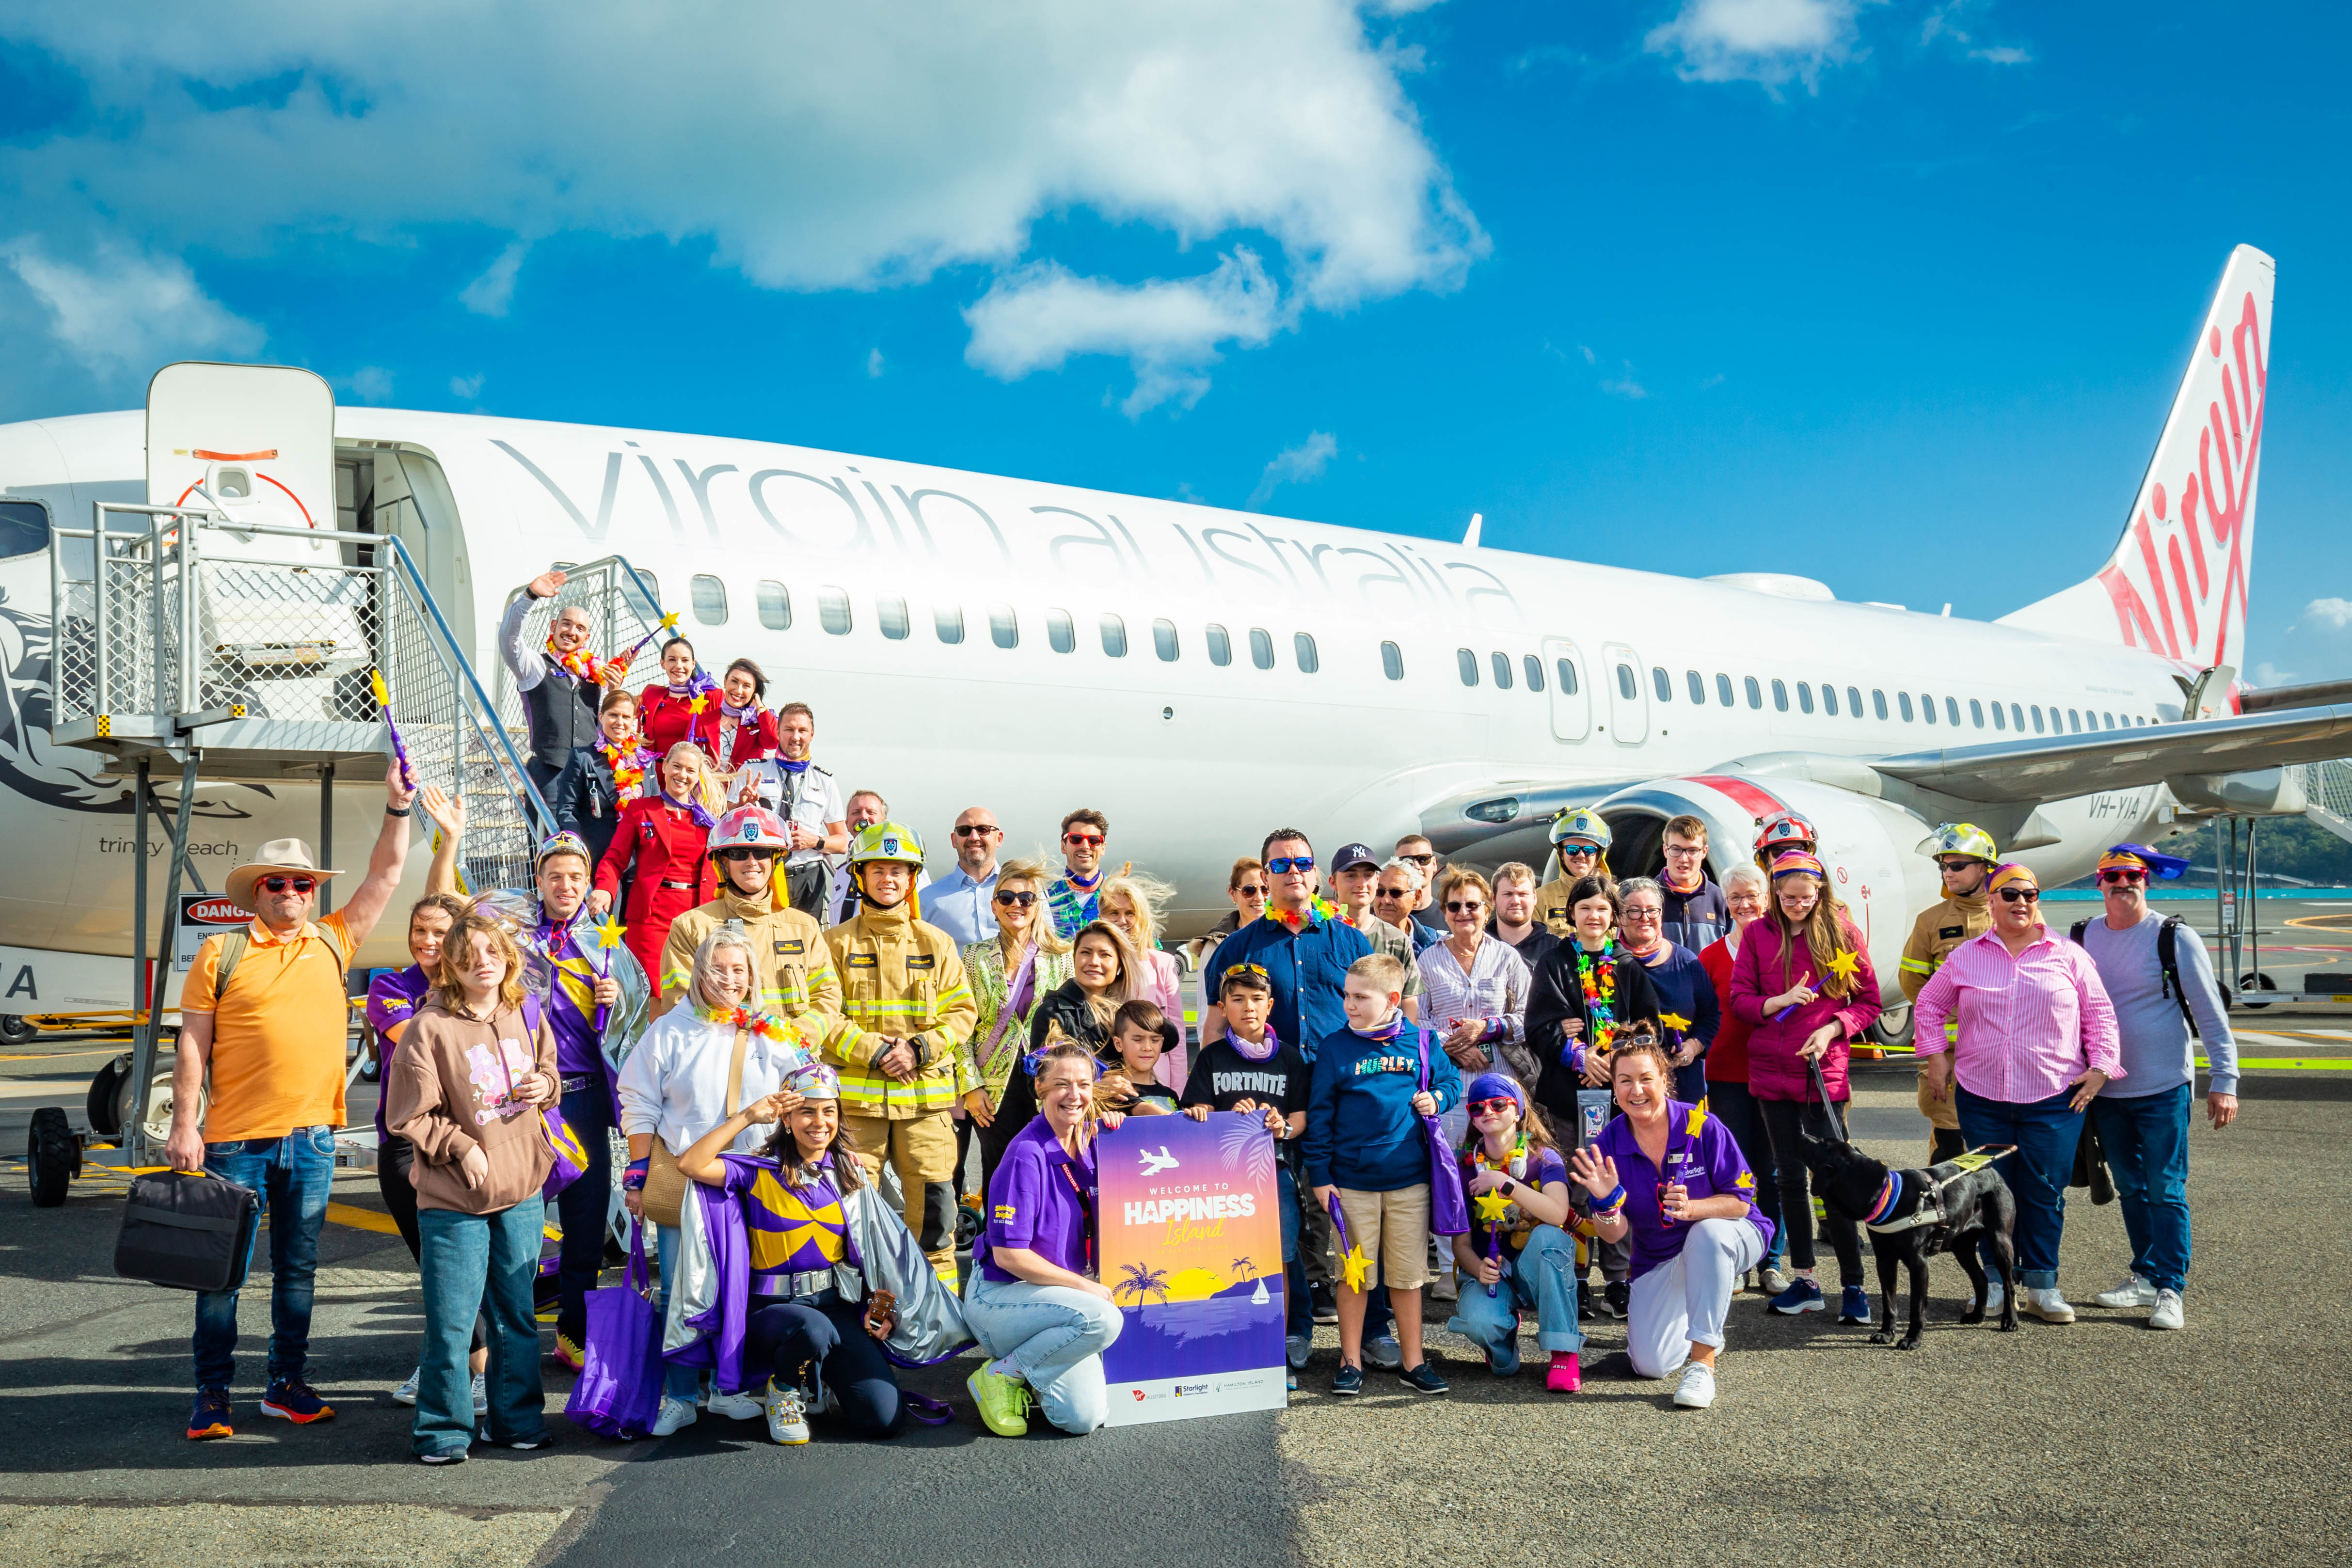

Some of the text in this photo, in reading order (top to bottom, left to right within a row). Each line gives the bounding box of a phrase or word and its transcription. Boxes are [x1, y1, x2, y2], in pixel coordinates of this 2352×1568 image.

[1028, 506, 1522, 623] australia
[2089, 795, 2140, 819] VH-YIA
[187, 840, 238, 855] each
[1212, 1072, 1287, 1097] FORTNITE
[1149, 1184, 1208, 1195] WELCOME
[1124, 1193, 1255, 1225] HAPPINESS
[1162, 1213, 1226, 1247] Island
[1183, 1384, 1208, 1392] Starlight
